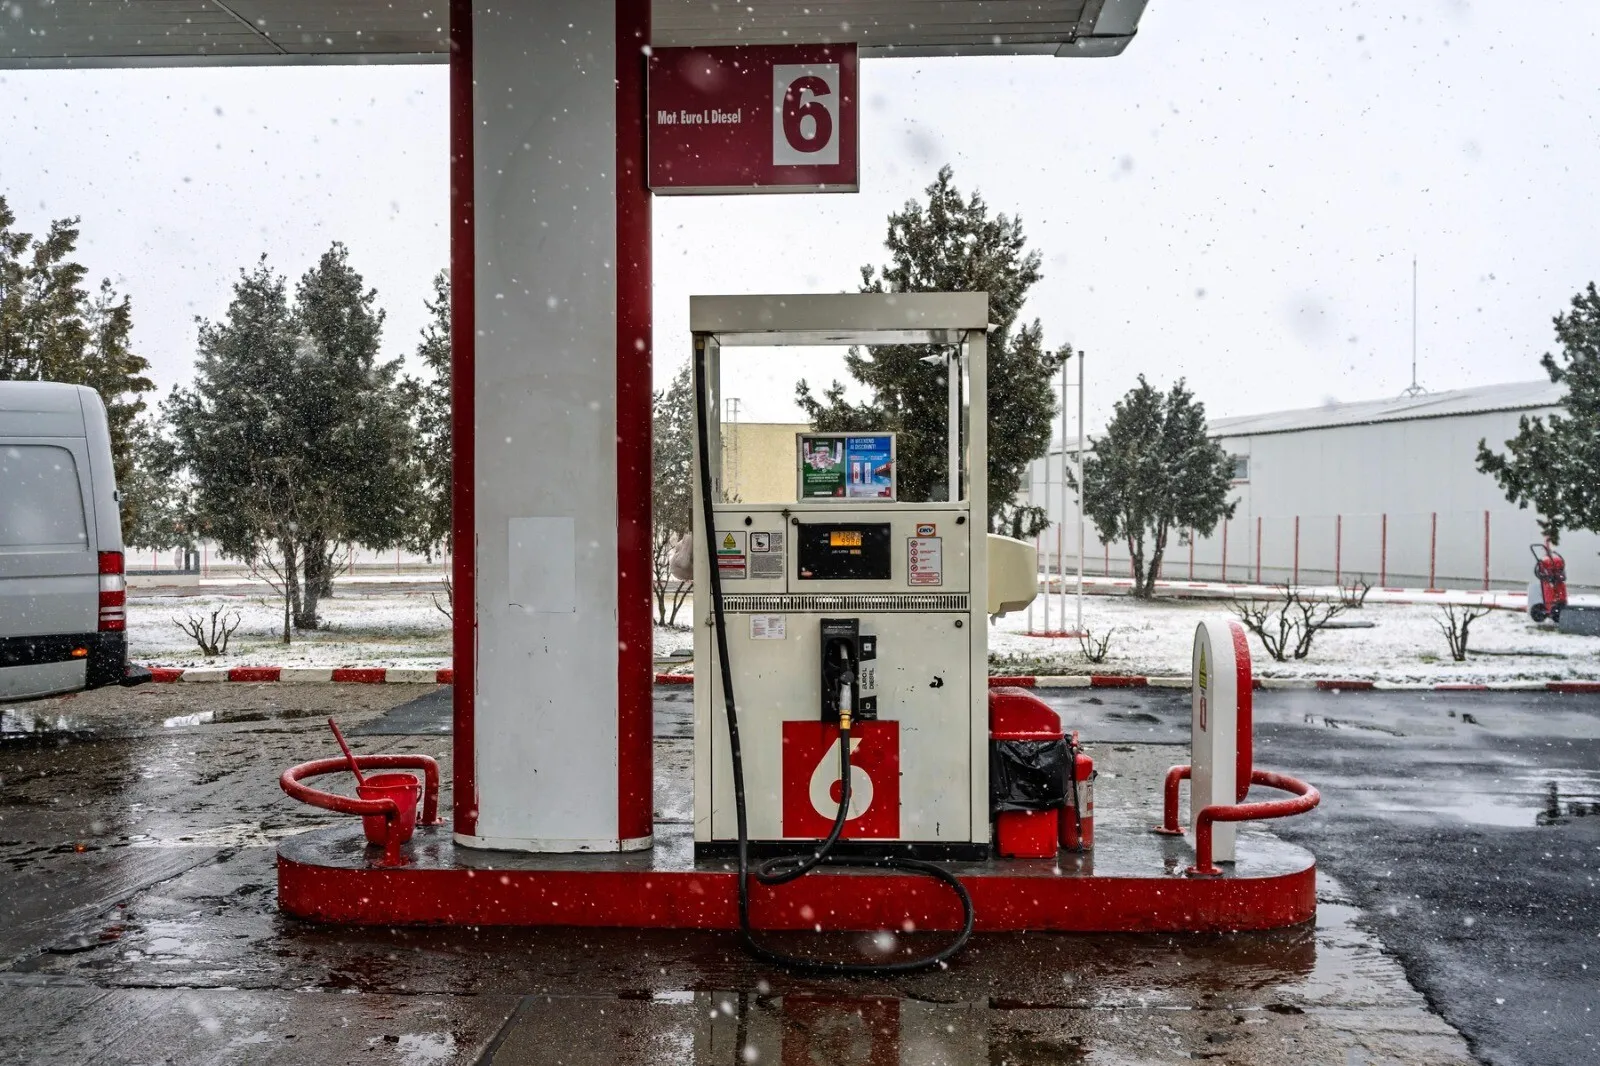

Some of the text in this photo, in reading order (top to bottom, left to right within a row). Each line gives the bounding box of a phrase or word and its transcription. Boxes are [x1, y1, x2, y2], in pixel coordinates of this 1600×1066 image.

[657, 108, 741, 125] Mot. Euro L Diesel
[782, 75, 833, 153] 6
[809, 737, 874, 821] 6
